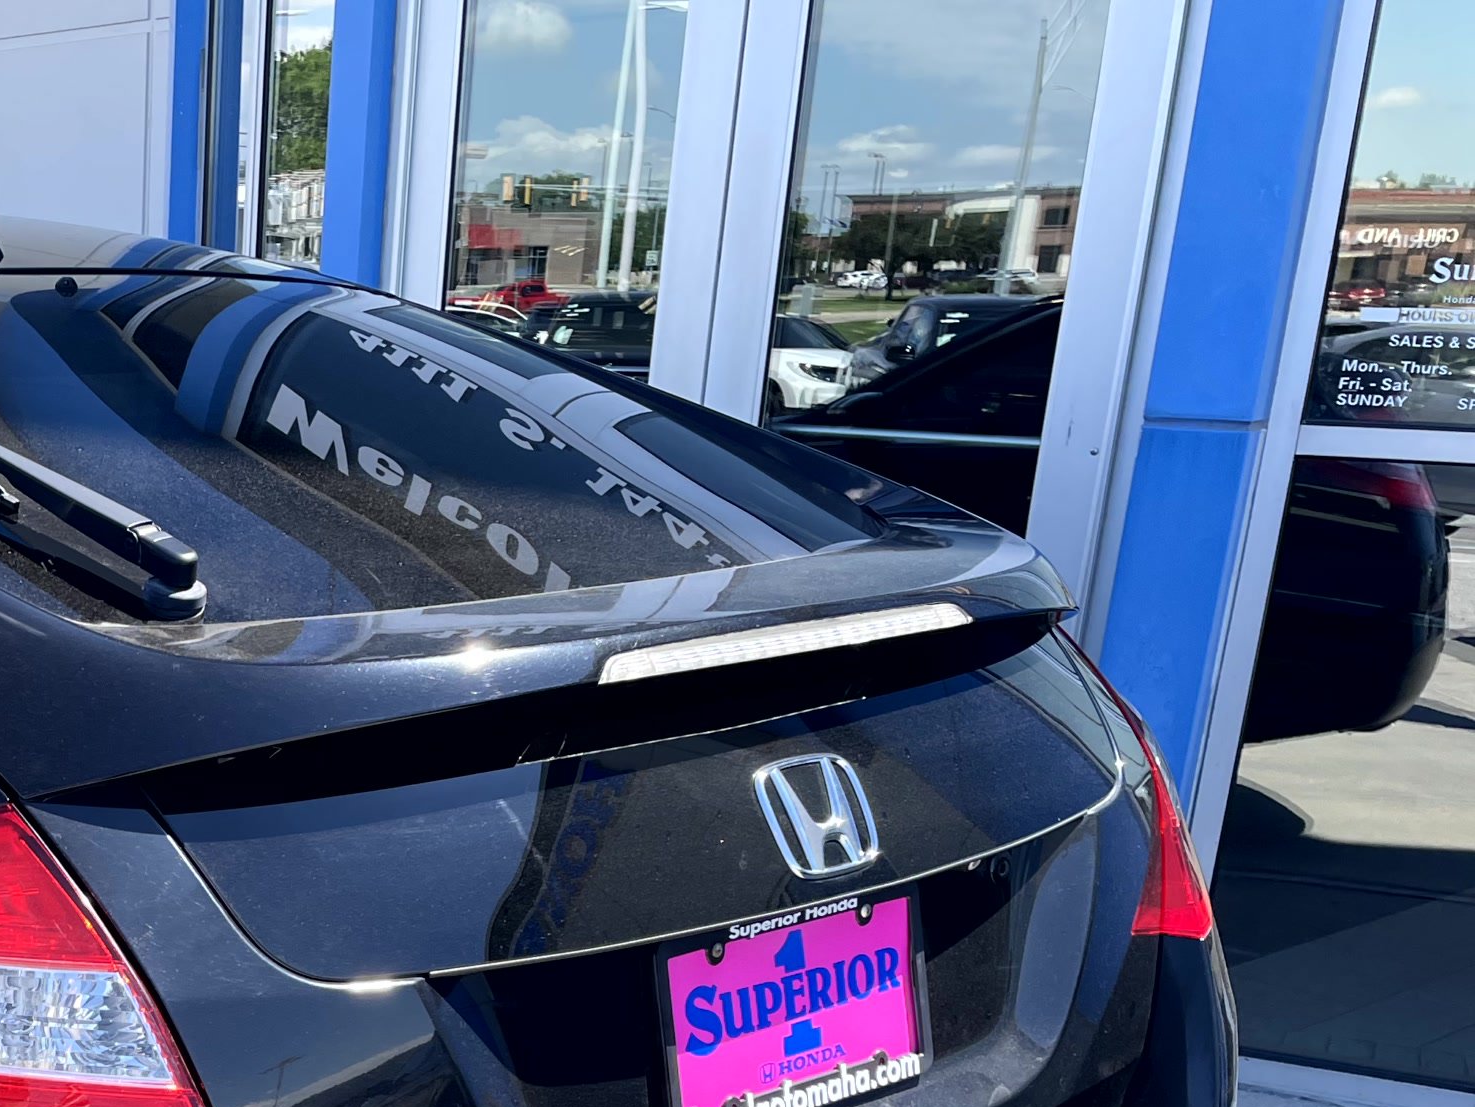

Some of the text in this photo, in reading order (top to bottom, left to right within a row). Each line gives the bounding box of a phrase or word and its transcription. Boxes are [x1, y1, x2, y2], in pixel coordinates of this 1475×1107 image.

[1399, 310, 1453, 323] HOURS
[1389, 335, 1444, 349] SALES
[1449, 336, 1460, 349] &
[1342, 359, 1383, 373] Mon.
[1401, 361, 1453, 375] Thurs.
[1338, 377, 1364, 391] Fri.
[1380, 378, 1413, 392] Sat.
[1335, 393, 1408, 407] SUNDAY
[729, 897, 858, 939] Superior Honda
[685, 947, 901, 1056] SUPERIOR
[778, 1044, 846, 1076] HONDA
